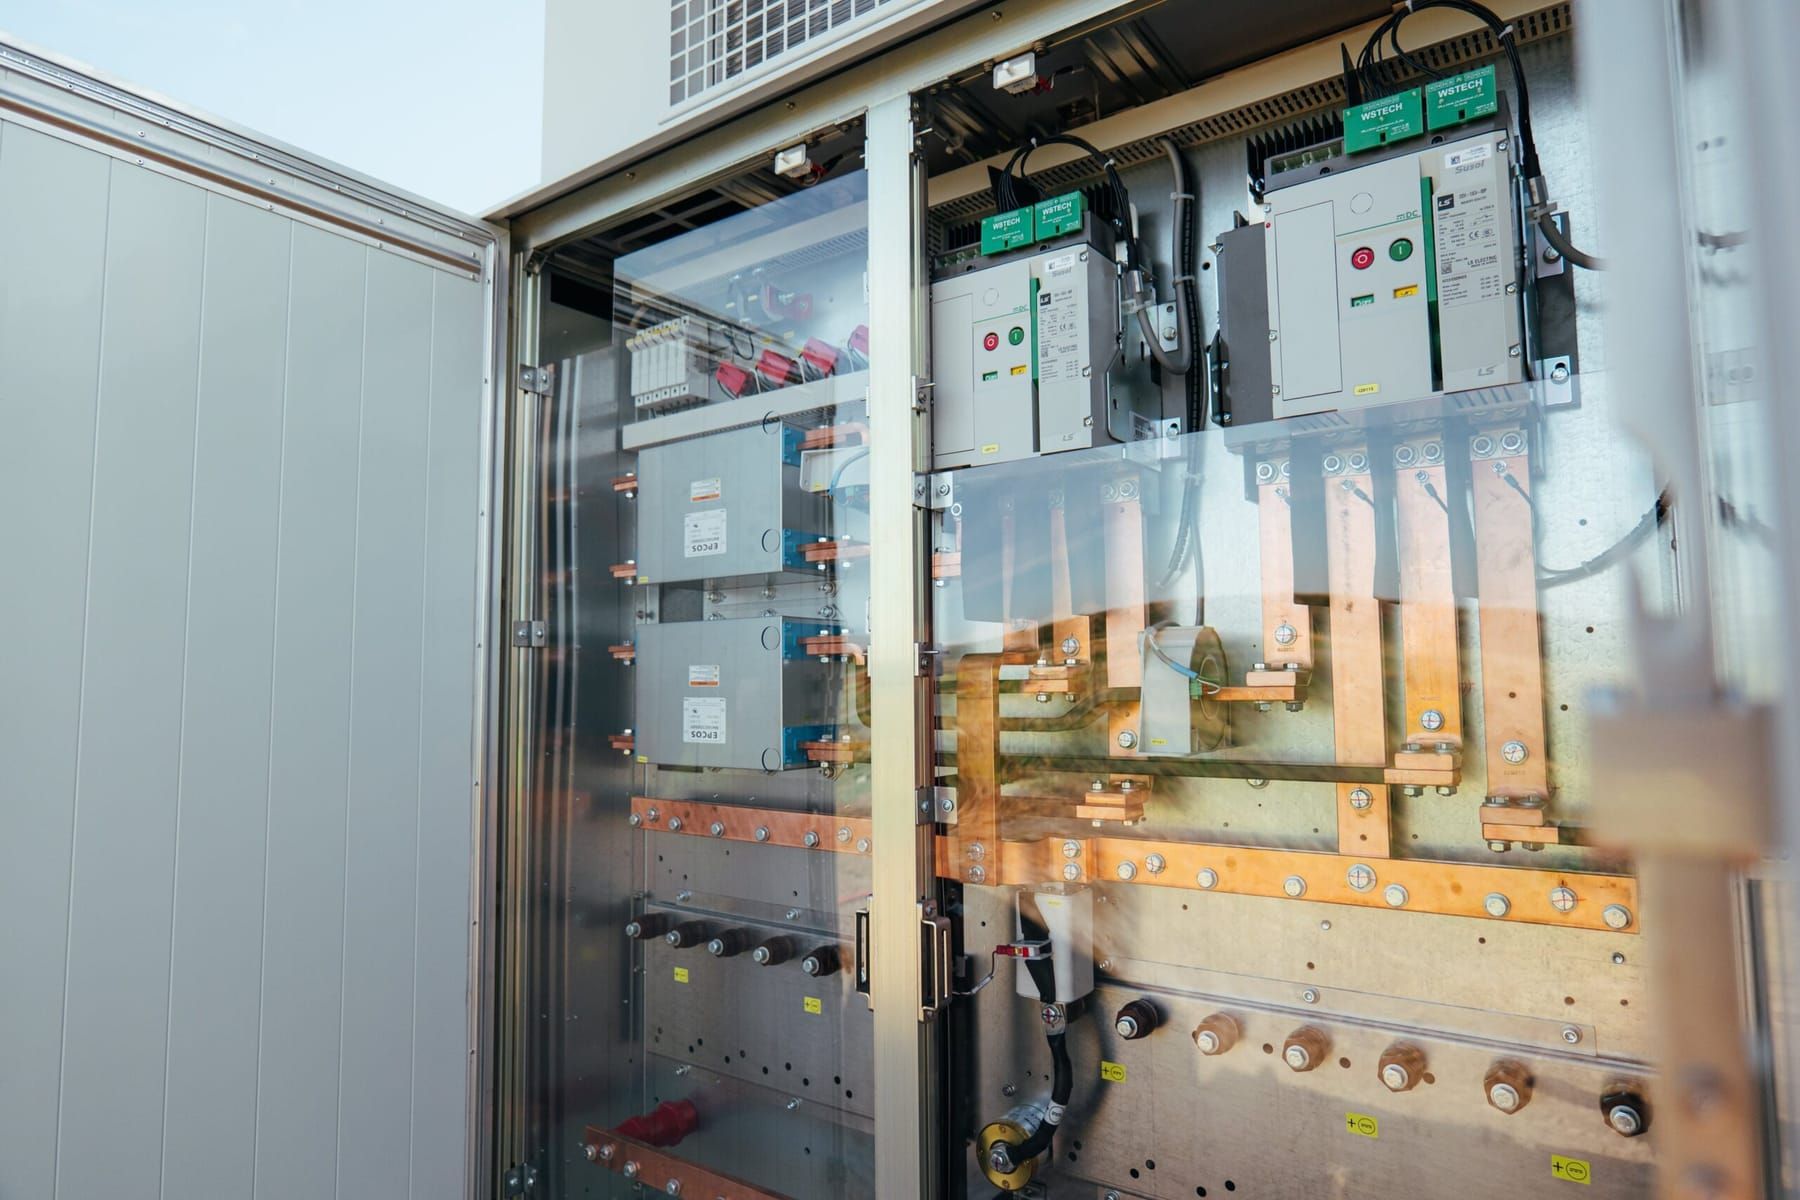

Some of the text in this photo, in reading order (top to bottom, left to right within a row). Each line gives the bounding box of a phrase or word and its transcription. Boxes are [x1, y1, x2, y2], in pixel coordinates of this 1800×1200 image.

[1438, 78, 1483, 98] WSTECH
[1360, 102, 1403, 121] WSTECH
[1042, 200, 1072, 216] WSTECH
[992, 216, 1021, 231] WSTECH
[691, 542, 719, 553] EPCOS
[690, 730, 718, 739] EPCOS
